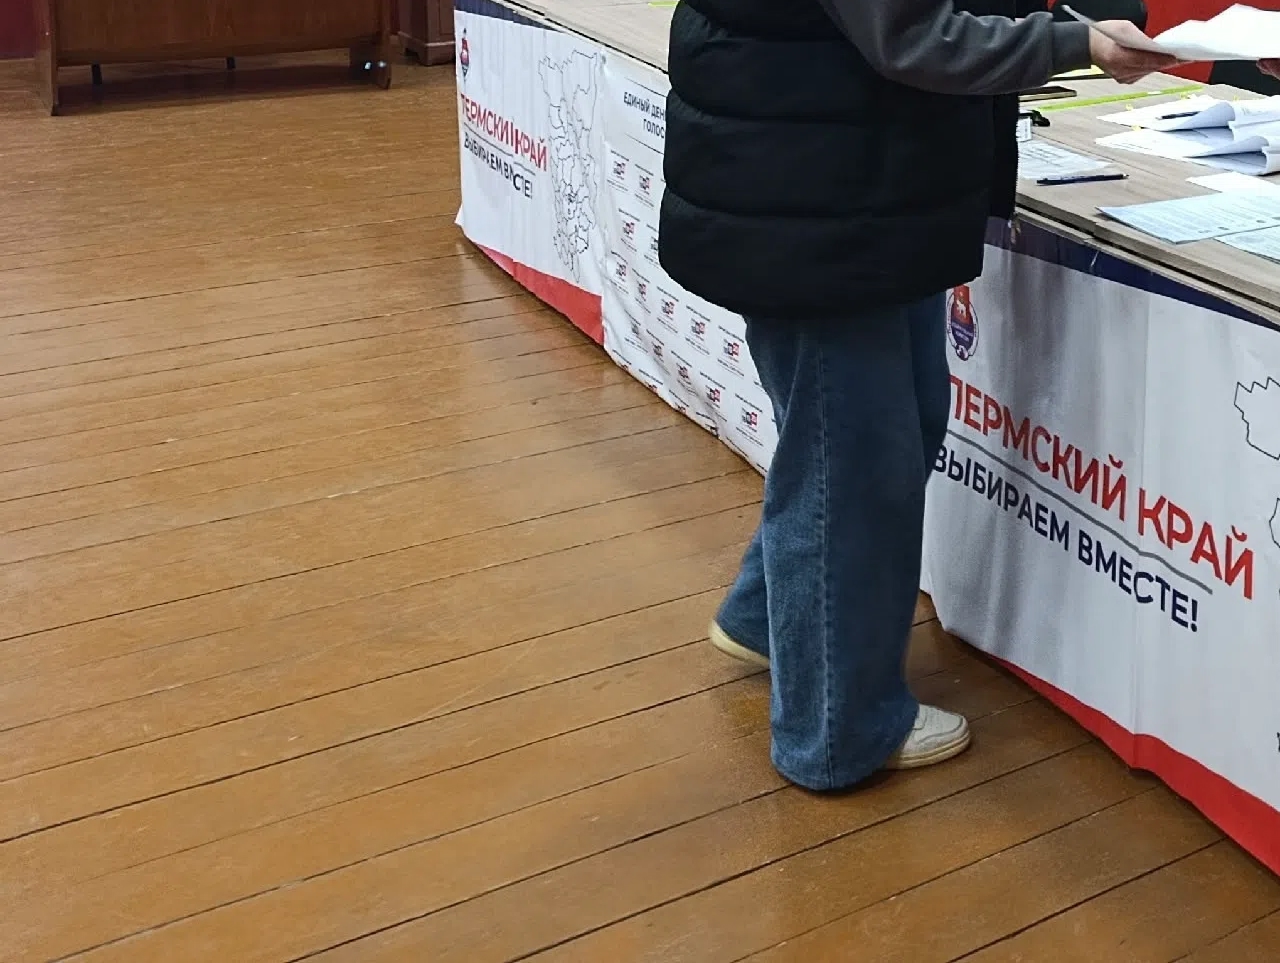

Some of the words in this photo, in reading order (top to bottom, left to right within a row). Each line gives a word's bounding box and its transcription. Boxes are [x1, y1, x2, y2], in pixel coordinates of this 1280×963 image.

[623, 91, 650, 114] ЕДИНЫЙ
[651, 104, 665, 121] ДЕН
[643, 118, 665, 138] ГОЛОС
[933, 444, 1070, 544] ВЫБИРАЕМ
[1077, 528, 1199, 632] ВМЕСТЕ!
[948, 373, 1127, 521] ПЕРМСКИЙ
[1137, 487, 1255, 600] КРАЙ
